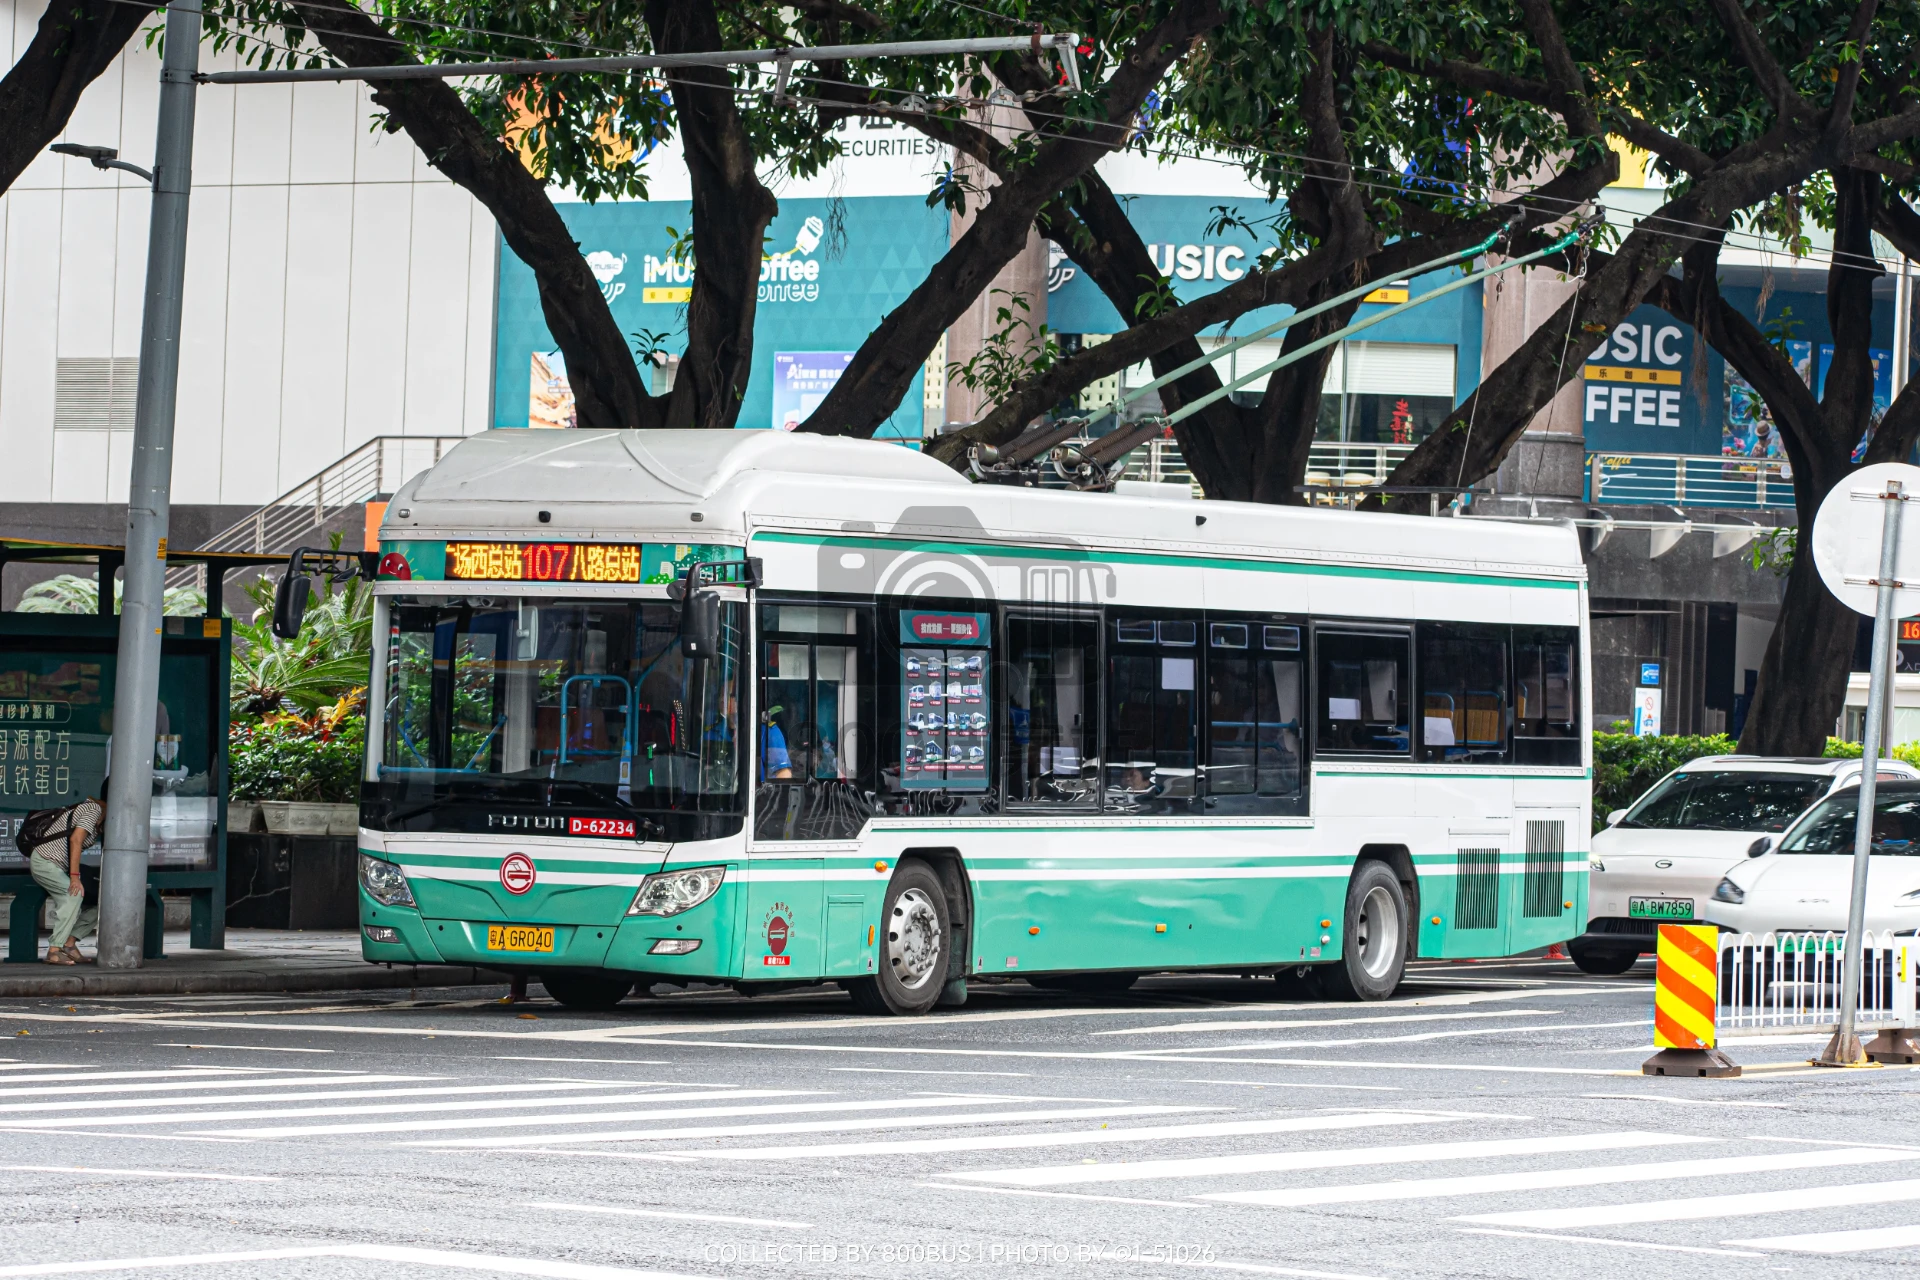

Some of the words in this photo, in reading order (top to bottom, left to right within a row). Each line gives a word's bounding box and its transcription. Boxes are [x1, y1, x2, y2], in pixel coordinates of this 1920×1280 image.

[840, 139, 935, 156] ECURITIES
[644, 254, 695, 283] iMU
[759, 252, 819, 282] offee
[1147, 244, 1245, 281] USIC
[1587, 323, 1683, 365] SIC
[523, 543, 570, 580] 107
[570, 545, 640, 581] 八路总站
[488, 814, 565, 829] FOTON
[572, 819, 634, 835] D-62234
